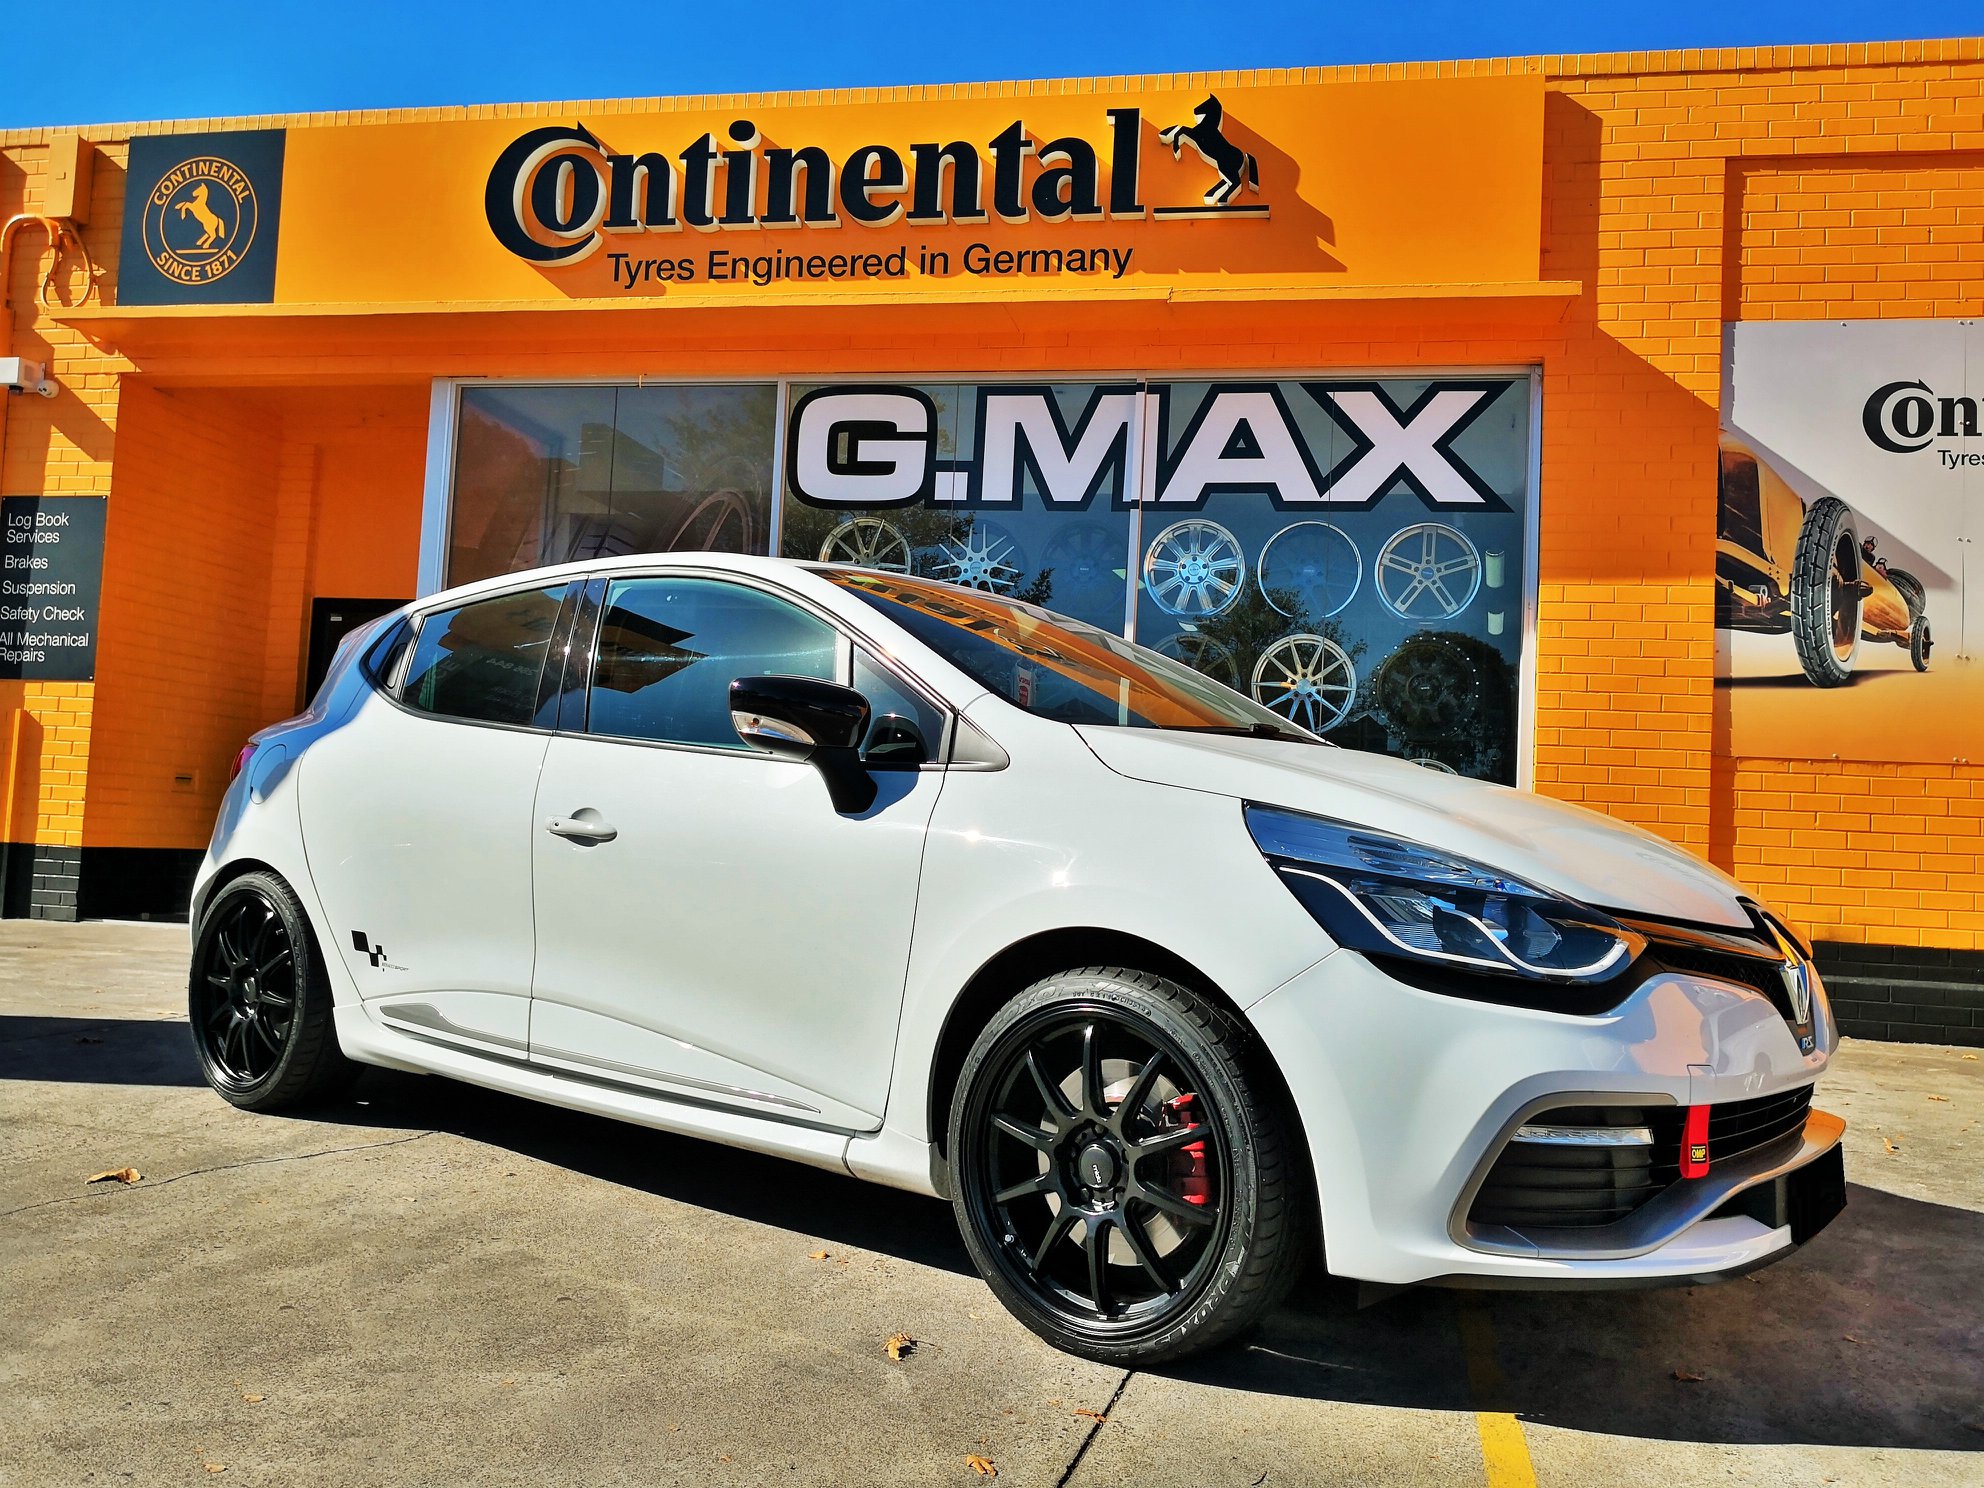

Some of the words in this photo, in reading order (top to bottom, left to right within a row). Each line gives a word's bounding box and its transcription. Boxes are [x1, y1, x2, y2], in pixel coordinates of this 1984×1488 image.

[153, 161, 251, 206] CONTINENTAL
[485, 108, 1146, 265] Continental
[156, 251, 201, 281] SINCE
[204, 249, 238, 278] 1871
[606, 252, 695, 289] Tyres
[708, 246, 906, 287] Engineered
[919, 245, 949, 275] in
[963, 243, 1133, 279] Germany
[1862, 378, 1984, 454] Con
[787, 381, 1513, 512] G.MAX
[8, 512, 32, 530] Log
[35, 512, 70, 528] Book
[6, 529, 60, 544] Services
[4, 554, 49, 570] Brakes
[2, 580, 76, 598] Suspension
[0, 605, 40, 624] Safety
[43, 605, 85, 621] Check
[0, 631, 14, 646] All
[17, 631, 89, 648] Mechanical
[0, 646, 46, 665] Repairs
[1691, 1148, 1706, 1159] OMP
